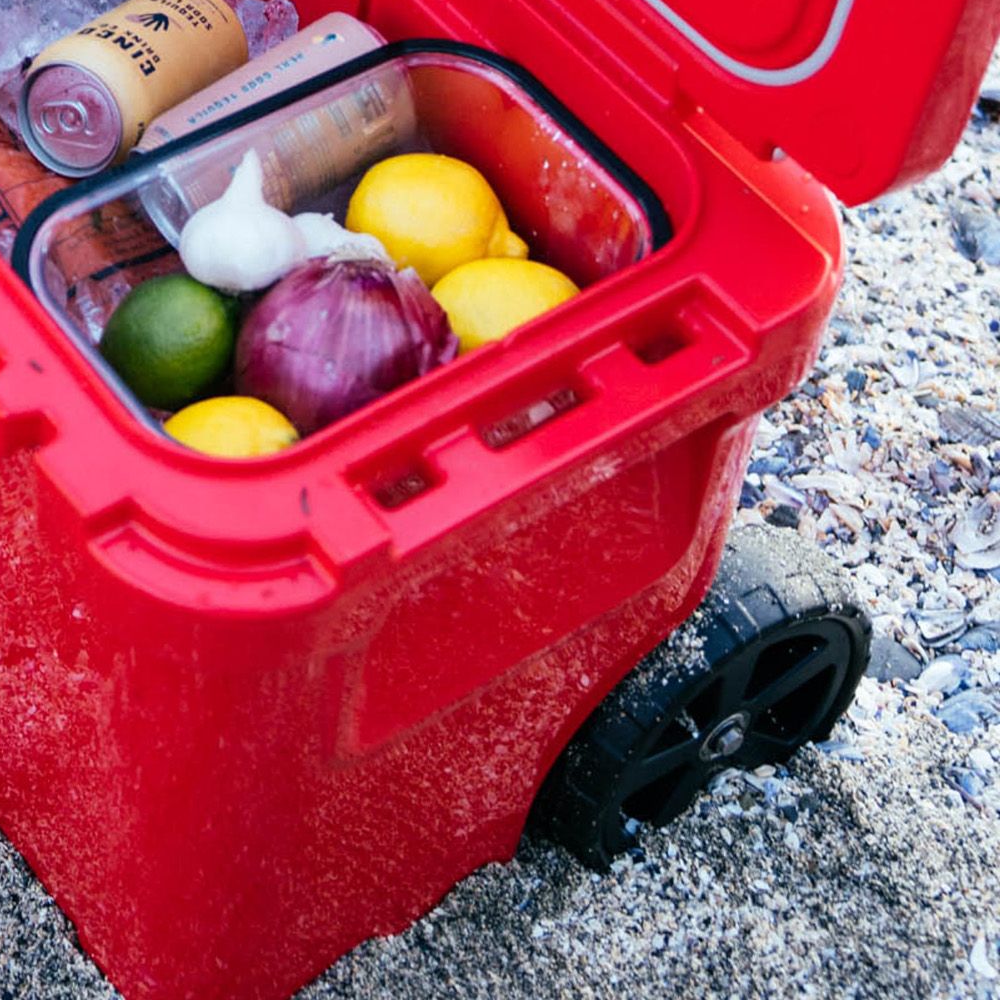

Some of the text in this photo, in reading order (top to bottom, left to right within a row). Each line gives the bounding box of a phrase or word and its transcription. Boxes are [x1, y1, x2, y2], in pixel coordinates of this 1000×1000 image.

[185, 4, 213, 31] SODA
[77, 26, 156, 77] CINCO
[125, 30, 161, 63] DRINK
[188, 93, 238, 124] TEQUILA
